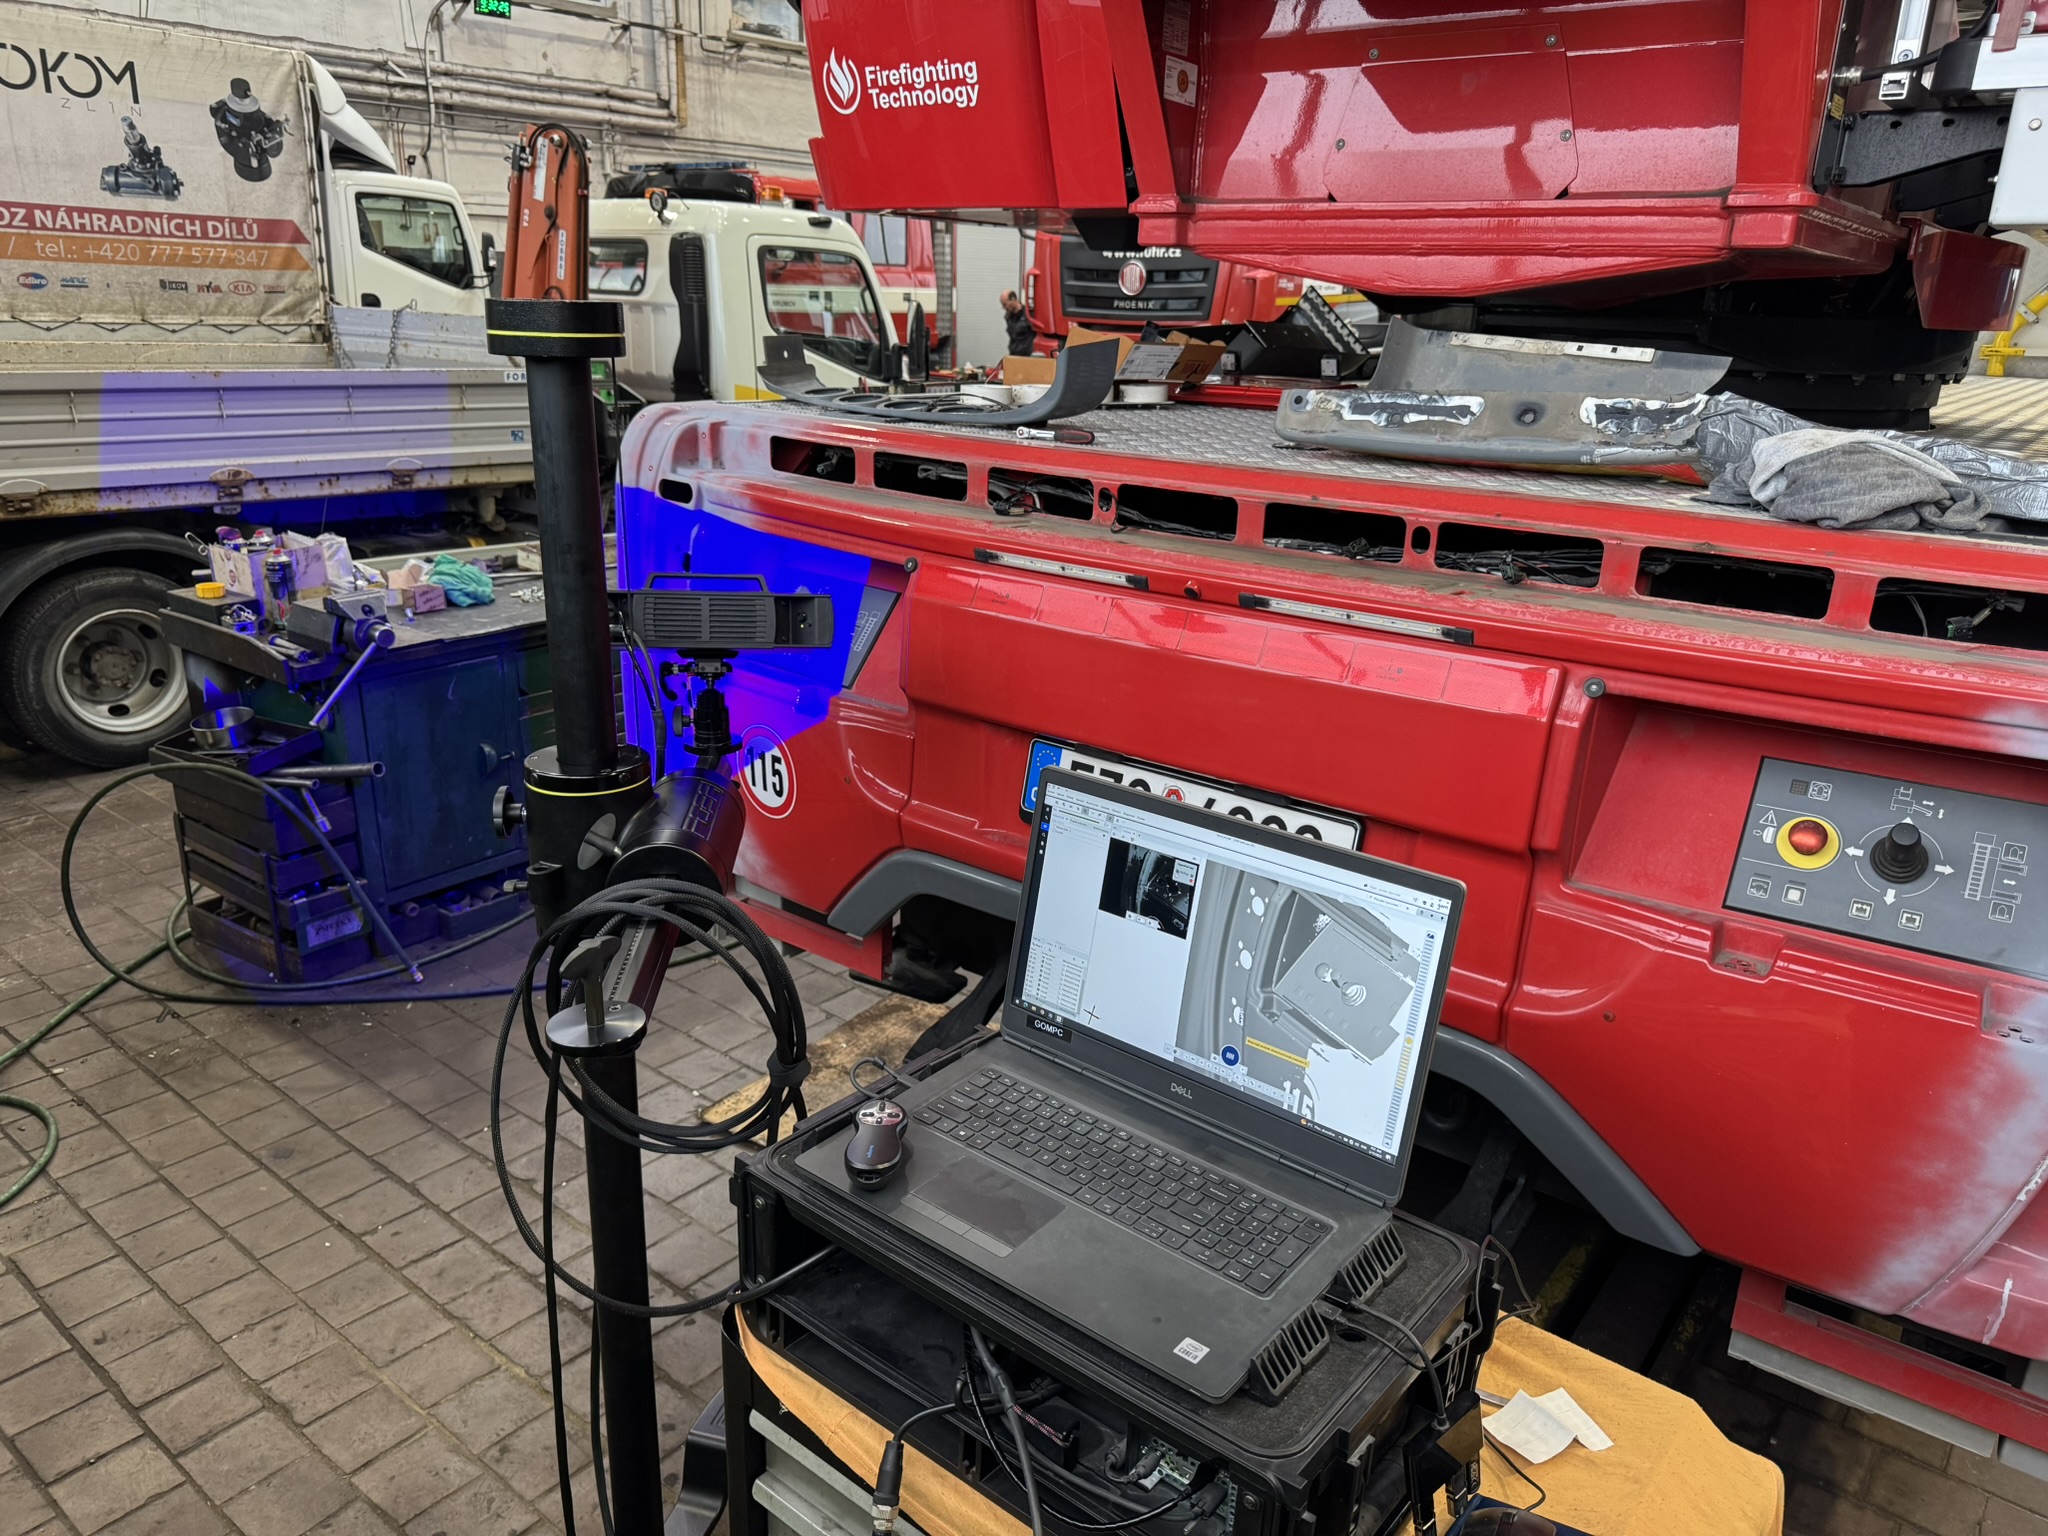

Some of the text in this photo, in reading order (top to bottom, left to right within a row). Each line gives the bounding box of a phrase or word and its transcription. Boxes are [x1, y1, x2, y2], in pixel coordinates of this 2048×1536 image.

[0, 42, 140, 104] OKOM
[865, 58, 978, 89] Firefighting
[868, 83, 979, 109] Technology
[33, 207, 202, 237] NÁHRADNÍCH
[207, 218, 259, 240] DÍLŮ
[35, 238, 78, 259] tel.:
[84, 242, 140, 261] +420
[146, 244, 184, 263] 777
[191, 247, 228, 266] 577
[234, 249, 269, 267] 847
[19, 275, 48, 286] Edbro
[1113, 299, 1155, 310] PHOENIX
[746, 746, 784, 798] 115
[1034, 1019, 1064, 1037] GOMPC
[1170, 1082, 1193, 1099] DELL
